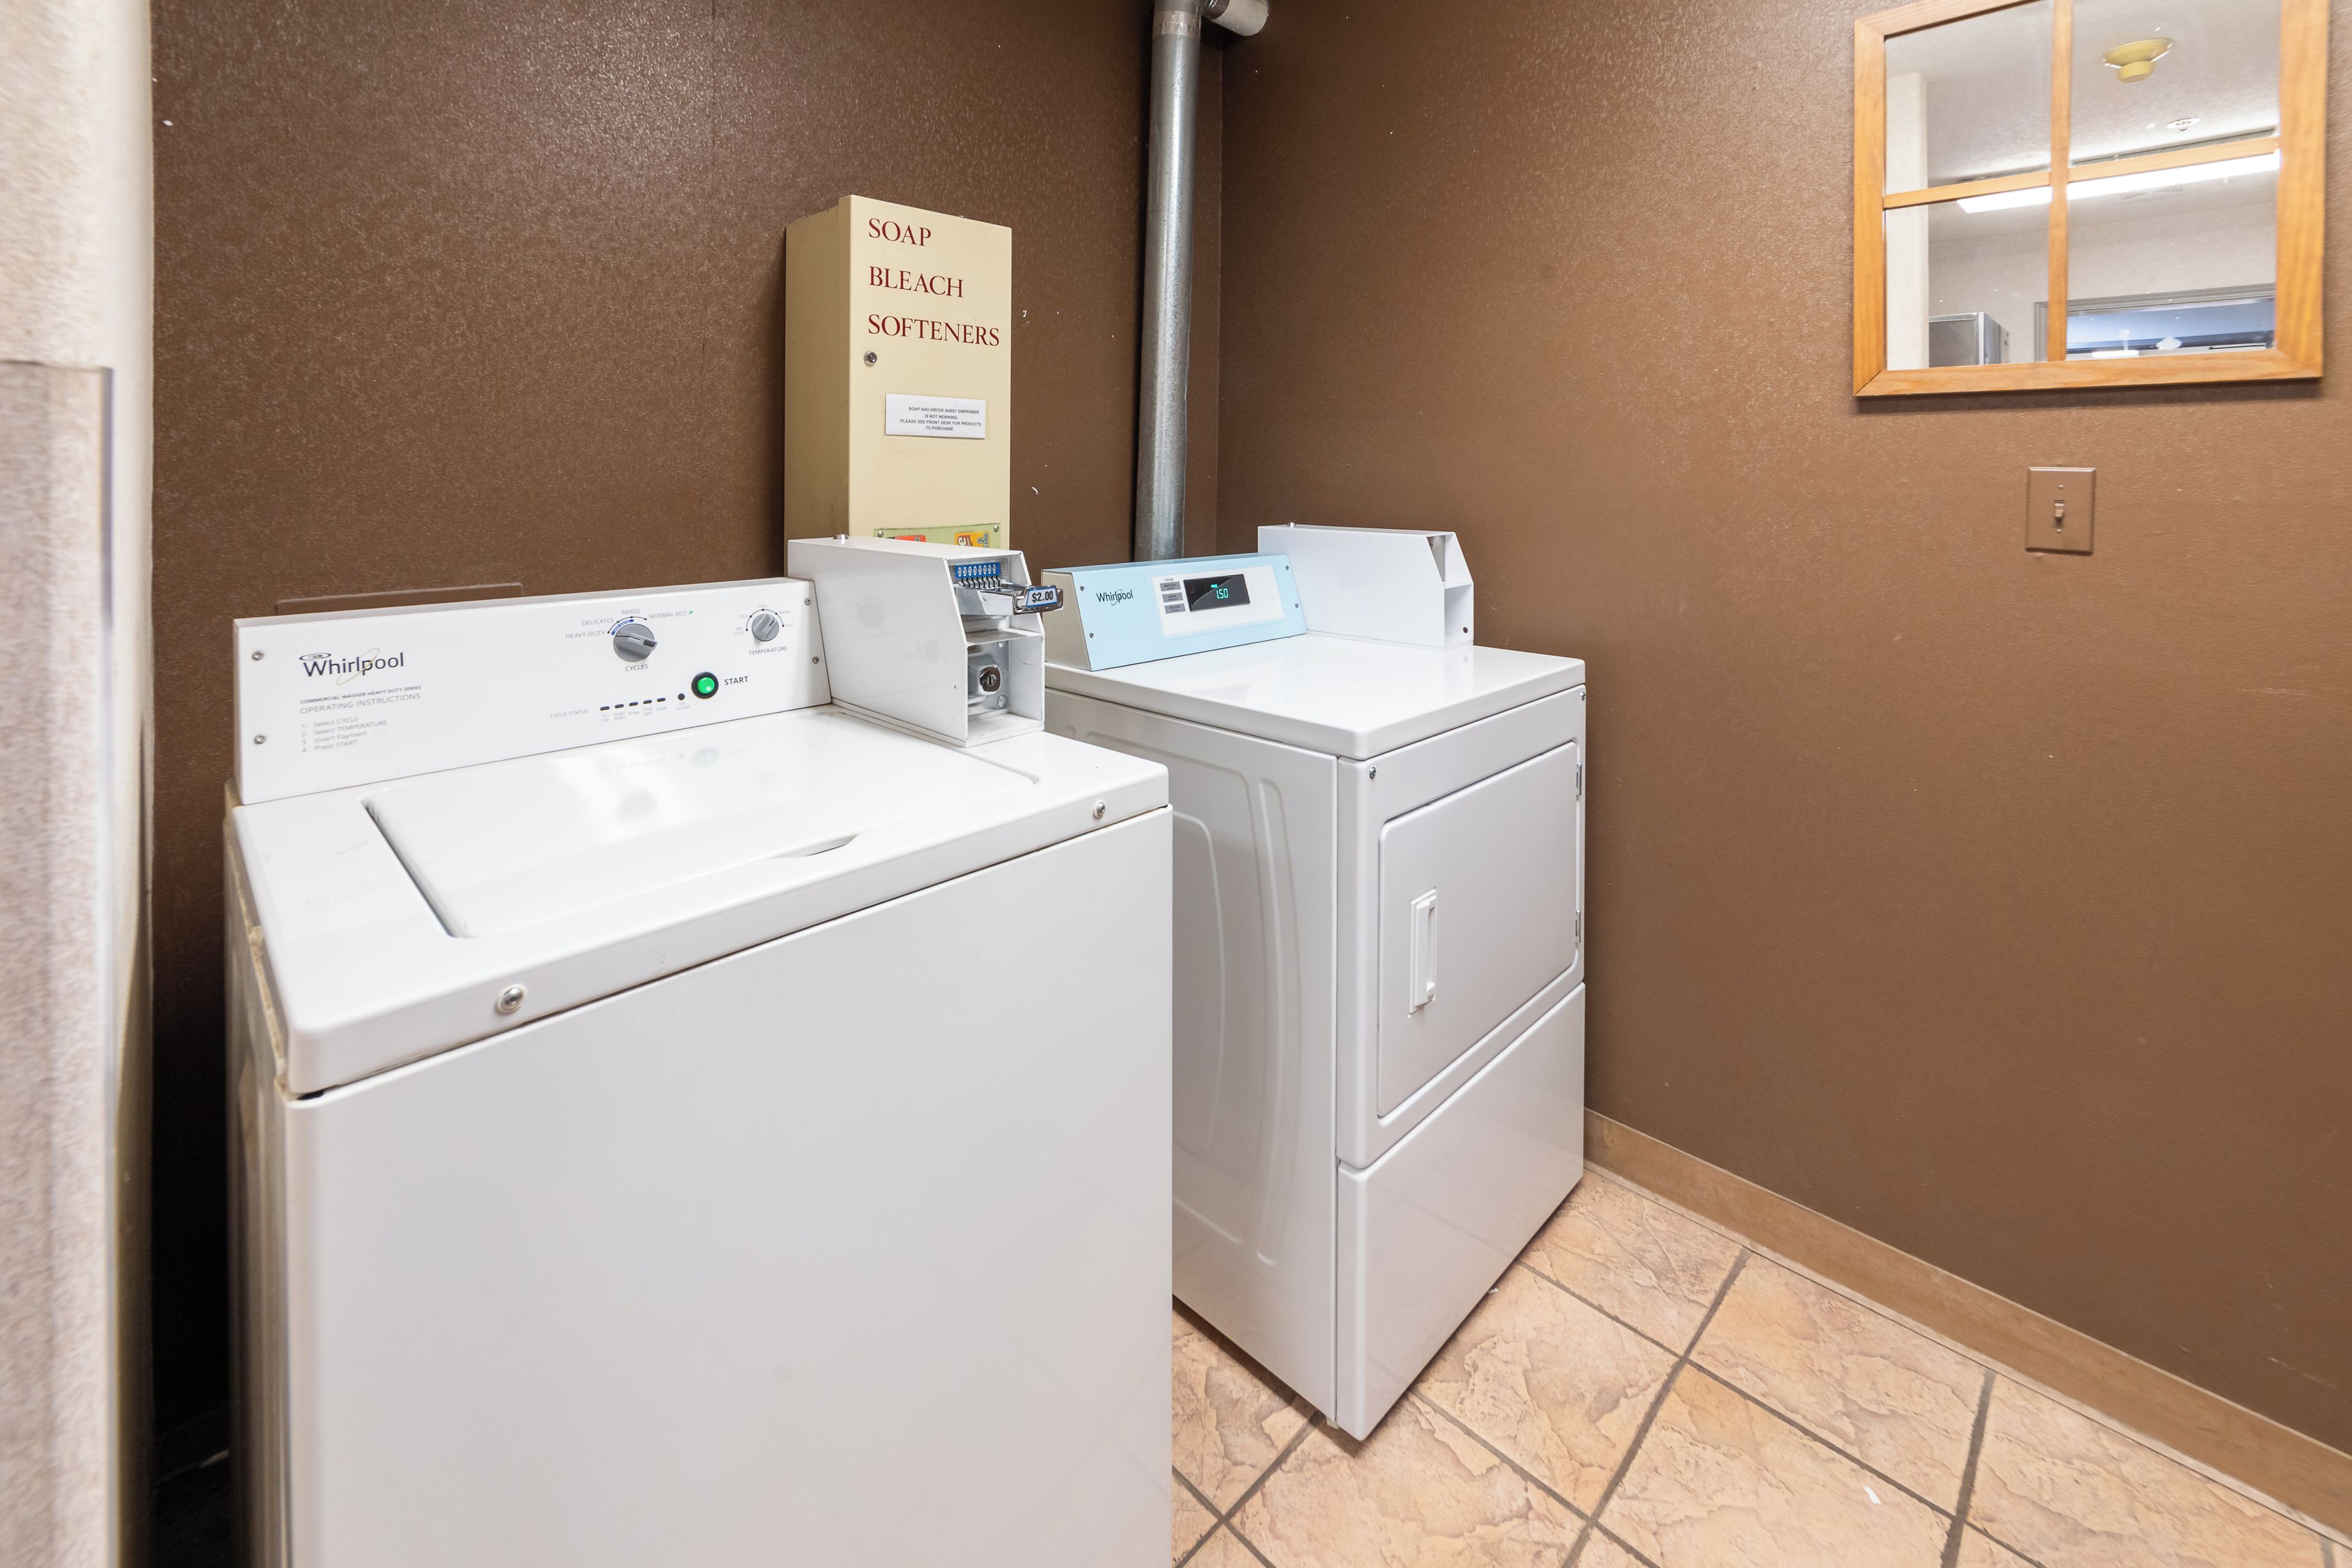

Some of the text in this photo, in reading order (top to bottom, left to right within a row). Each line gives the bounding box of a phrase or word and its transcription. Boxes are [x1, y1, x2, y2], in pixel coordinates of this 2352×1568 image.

[868, 217, 932, 247] SOAP
[868, 265, 964, 298] BLEACH
[867, 313, 1001, 347] SOFTENERS
[1031, 590, 1054, 603] $2.00
[1096, 590, 1133, 603] Whirlpool
[582, 617, 614, 626] DELICATES
[748, 646, 788, 655] TEMPERATURE
[303, 652, 404, 677] Whirlpool
[625, 663, 649, 672] CYCLES
[724, 676, 748, 685] START
[300, 696, 339, 704] COMMERCIAL
[300, 693, 421, 714] OPERATING INSTRUCTIONS
[336, 716, 358, 725] CYCLE
[337, 720, 387, 732] TEMPERATURE
[314, 735, 335, 744] Insert
[337, 731, 368, 740] Payment
[336, 739, 358, 748] START
